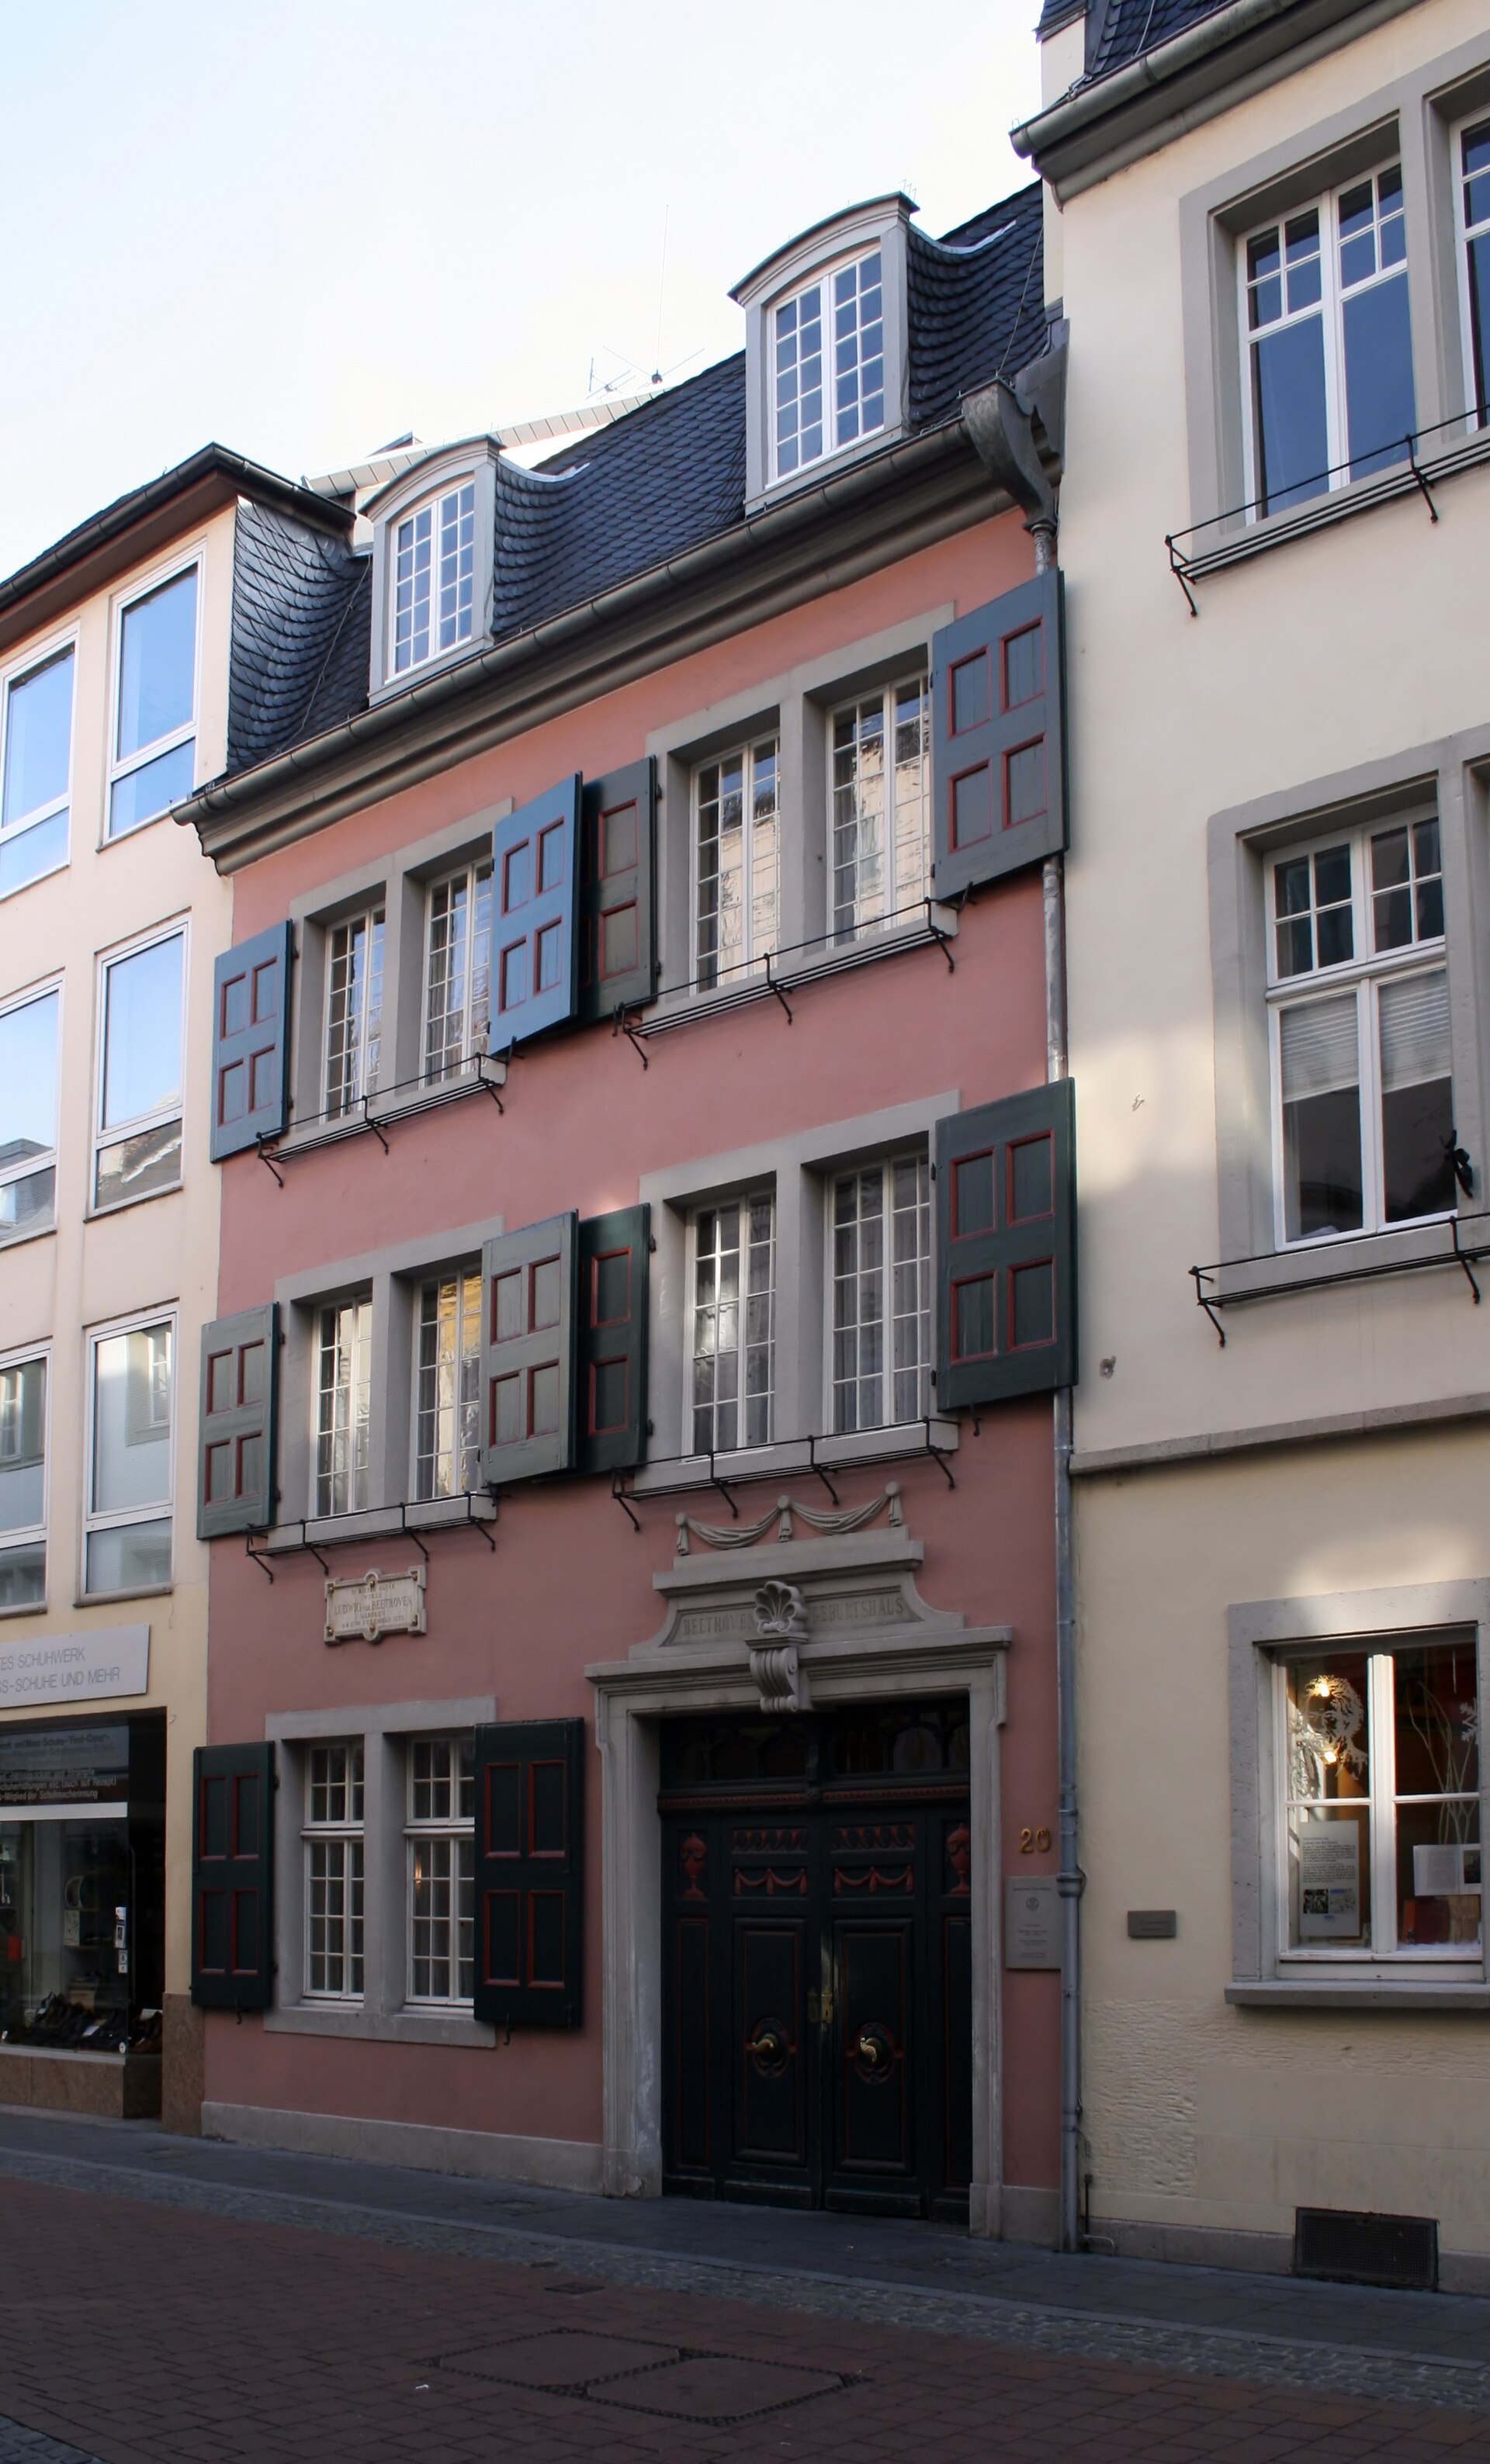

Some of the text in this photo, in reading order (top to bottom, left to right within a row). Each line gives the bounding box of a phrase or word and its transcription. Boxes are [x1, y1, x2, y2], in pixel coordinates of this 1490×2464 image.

[371, 1595, 412, 1611] BEETHOVEN
[813, 1597, 903, 1623] GEBURTSHAUS
[18, 1646, 86, 1669] SCHUHWERK
[61, 1670, 85, 1687] UND
[88, 1666, 121, 1684] MEHR
[1020, 1827, 1050, 1853] 20
